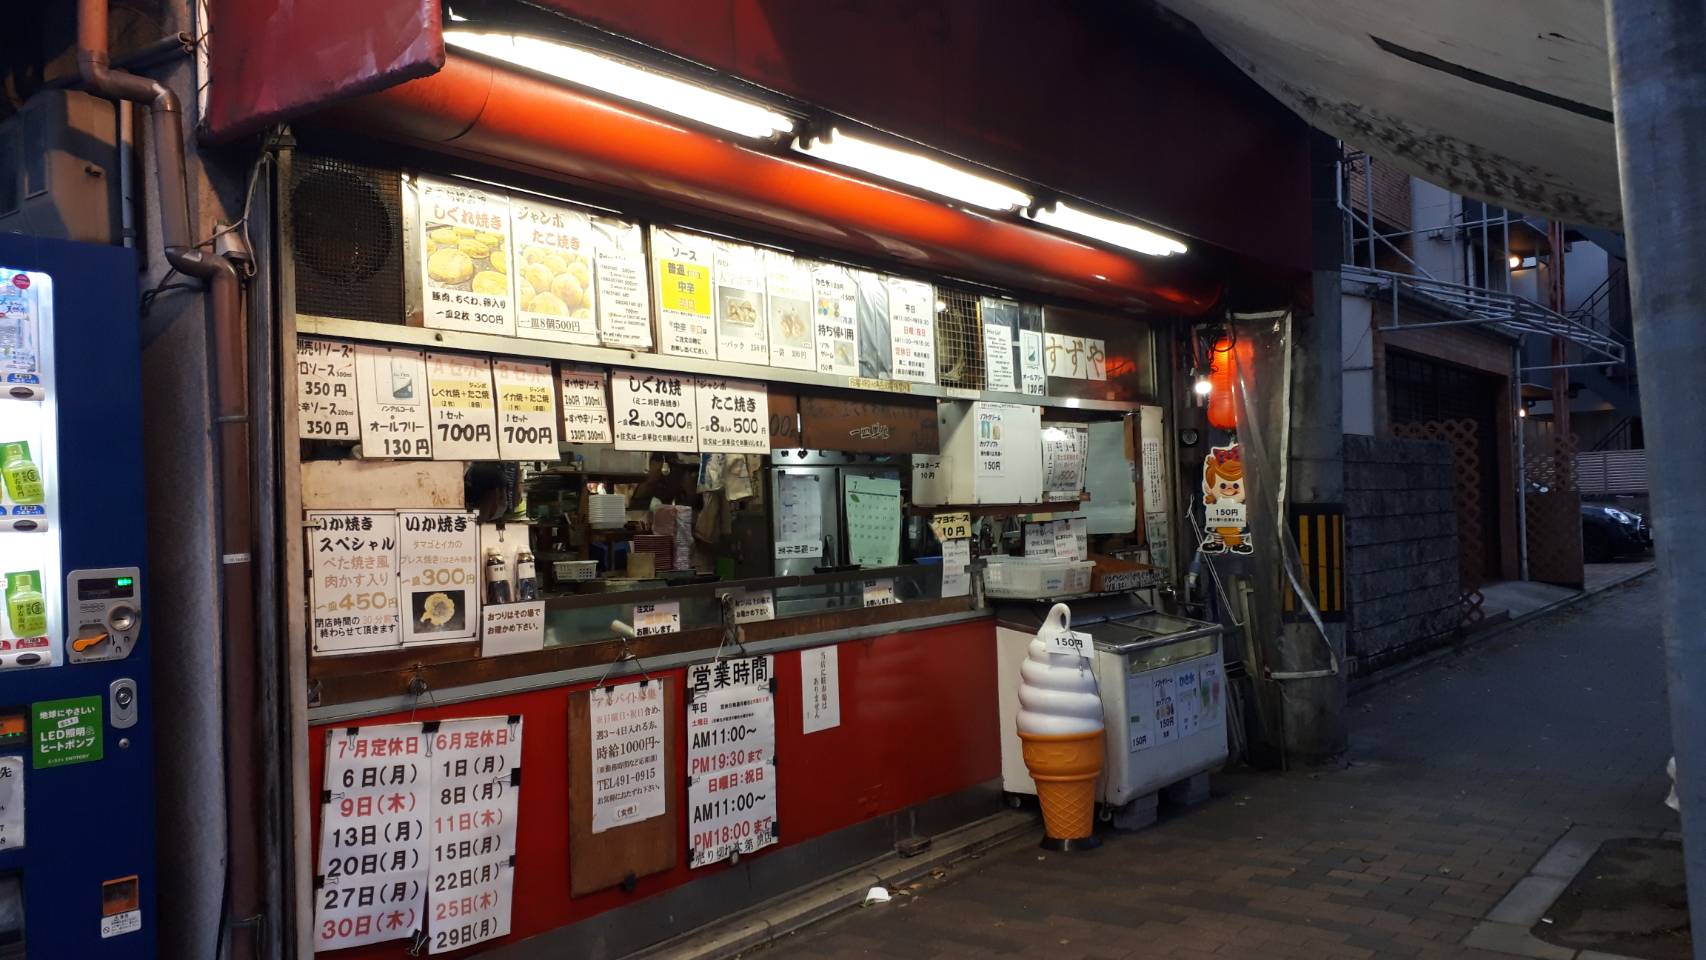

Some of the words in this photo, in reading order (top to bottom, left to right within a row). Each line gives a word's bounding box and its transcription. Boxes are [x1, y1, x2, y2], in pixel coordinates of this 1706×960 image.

[434, 204, 502, 230] しぐれ焼き
[517, 206, 564, 228] ジャンボ
[532, 230, 581, 251] たこ焼き
[672, 246, 697, 262] ソース
[677, 281, 695, 294] 中辛
[474, 310, 504, 325] 300円
[905, 304, 916, 314] 平日
[817, 324, 854, 341] 持ち帰り用
[1046, 337, 1104, 377] すずや
[305, 381, 347, 397] 350円
[629, 375, 682, 397] しぐれ焼
[699, 380, 727, 391] ジャンボ
[711, 394, 757, 413] たこ焼き
[307, 420, 349, 436] 350円
[370, 421, 424, 432] オールフリー
[437, 423, 491, 443] 700円
[504, 426, 552, 444] 700円
[384, 438, 430, 455] 130円
[984, 461, 1001, 471] 150円
[936, 515, 969, 523] マヨネーズ
[1216, 508, 1238, 516] 150円
[405, 515, 467, 533] いか焼き
[942, 526, 965, 537] 10円
[319, 536, 395, 552] スペシャル
[413, 540, 463, 549] タマゴとイカの
[325, 573, 388, 589] 肉かす入り
[488, 608, 541, 621] おつりはその場で
[636, 604, 655, 614] 注文は
[320, 624, 396, 639] 終わらせて頂きます
[636, 624, 675, 636] お願いします。
[1055, 638, 1083, 648] 150円
[692, 657, 767, 693] 営業時間
[40, 706, 95, 720] 地球にやさしい
[692, 702, 707, 714] 平日
[692, 718, 708, 727] 土曜日
[1160, 716, 1175, 728] 150円
[40, 737, 96, 753] ヒートポンプ
[338, 736, 419, 759] 7月定休日
[436, 729, 508, 750] 6月定休日
[1132, 735, 1147, 747] 150円
[442, 755, 505, 777] 1日(月)
[691, 750, 745, 775] PM19:30
[747, 749, 763, 764] まで
[343, 764, 417, 788] 6日(月)
[597, 768, 656, 792] TEL491-0915
[440, 781, 502, 805] 8日(月)
[340, 793, 416, 817] 9日(木)
[435, 808, 503, 833] 11日(木)
[332, 820, 422, 848] 13日(月)
[693, 820, 750, 849] PM18:00
[435, 835, 501, 861] 15日(月)
[327, 849, 419, 878] 20日(月)
[435, 863, 500, 892] 22日(月)
[324, 881, 419, 909] 27日(月)
[436, 891, 498, 920] 25日(木)
[321, 909, 416, 939] 30日(木)
[436, 917, 497, 950] 29日(月)
